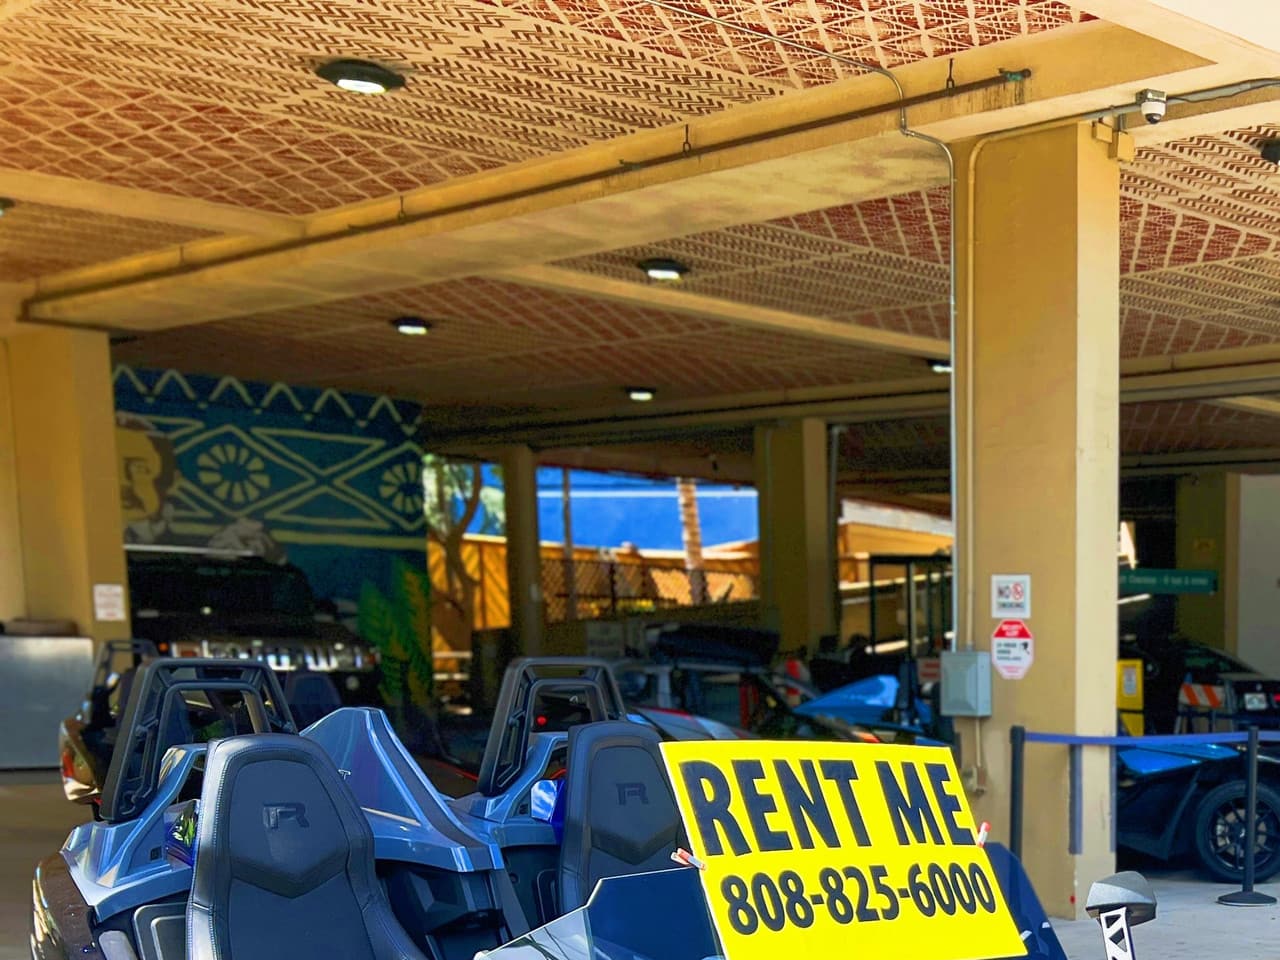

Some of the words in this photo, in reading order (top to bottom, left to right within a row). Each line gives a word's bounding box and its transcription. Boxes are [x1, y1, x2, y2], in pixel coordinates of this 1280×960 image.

[678, 759, 872, 857] RENT
[874, 761, 977, 846] ME
[720, 862, 997, 935] 808-825-6000
